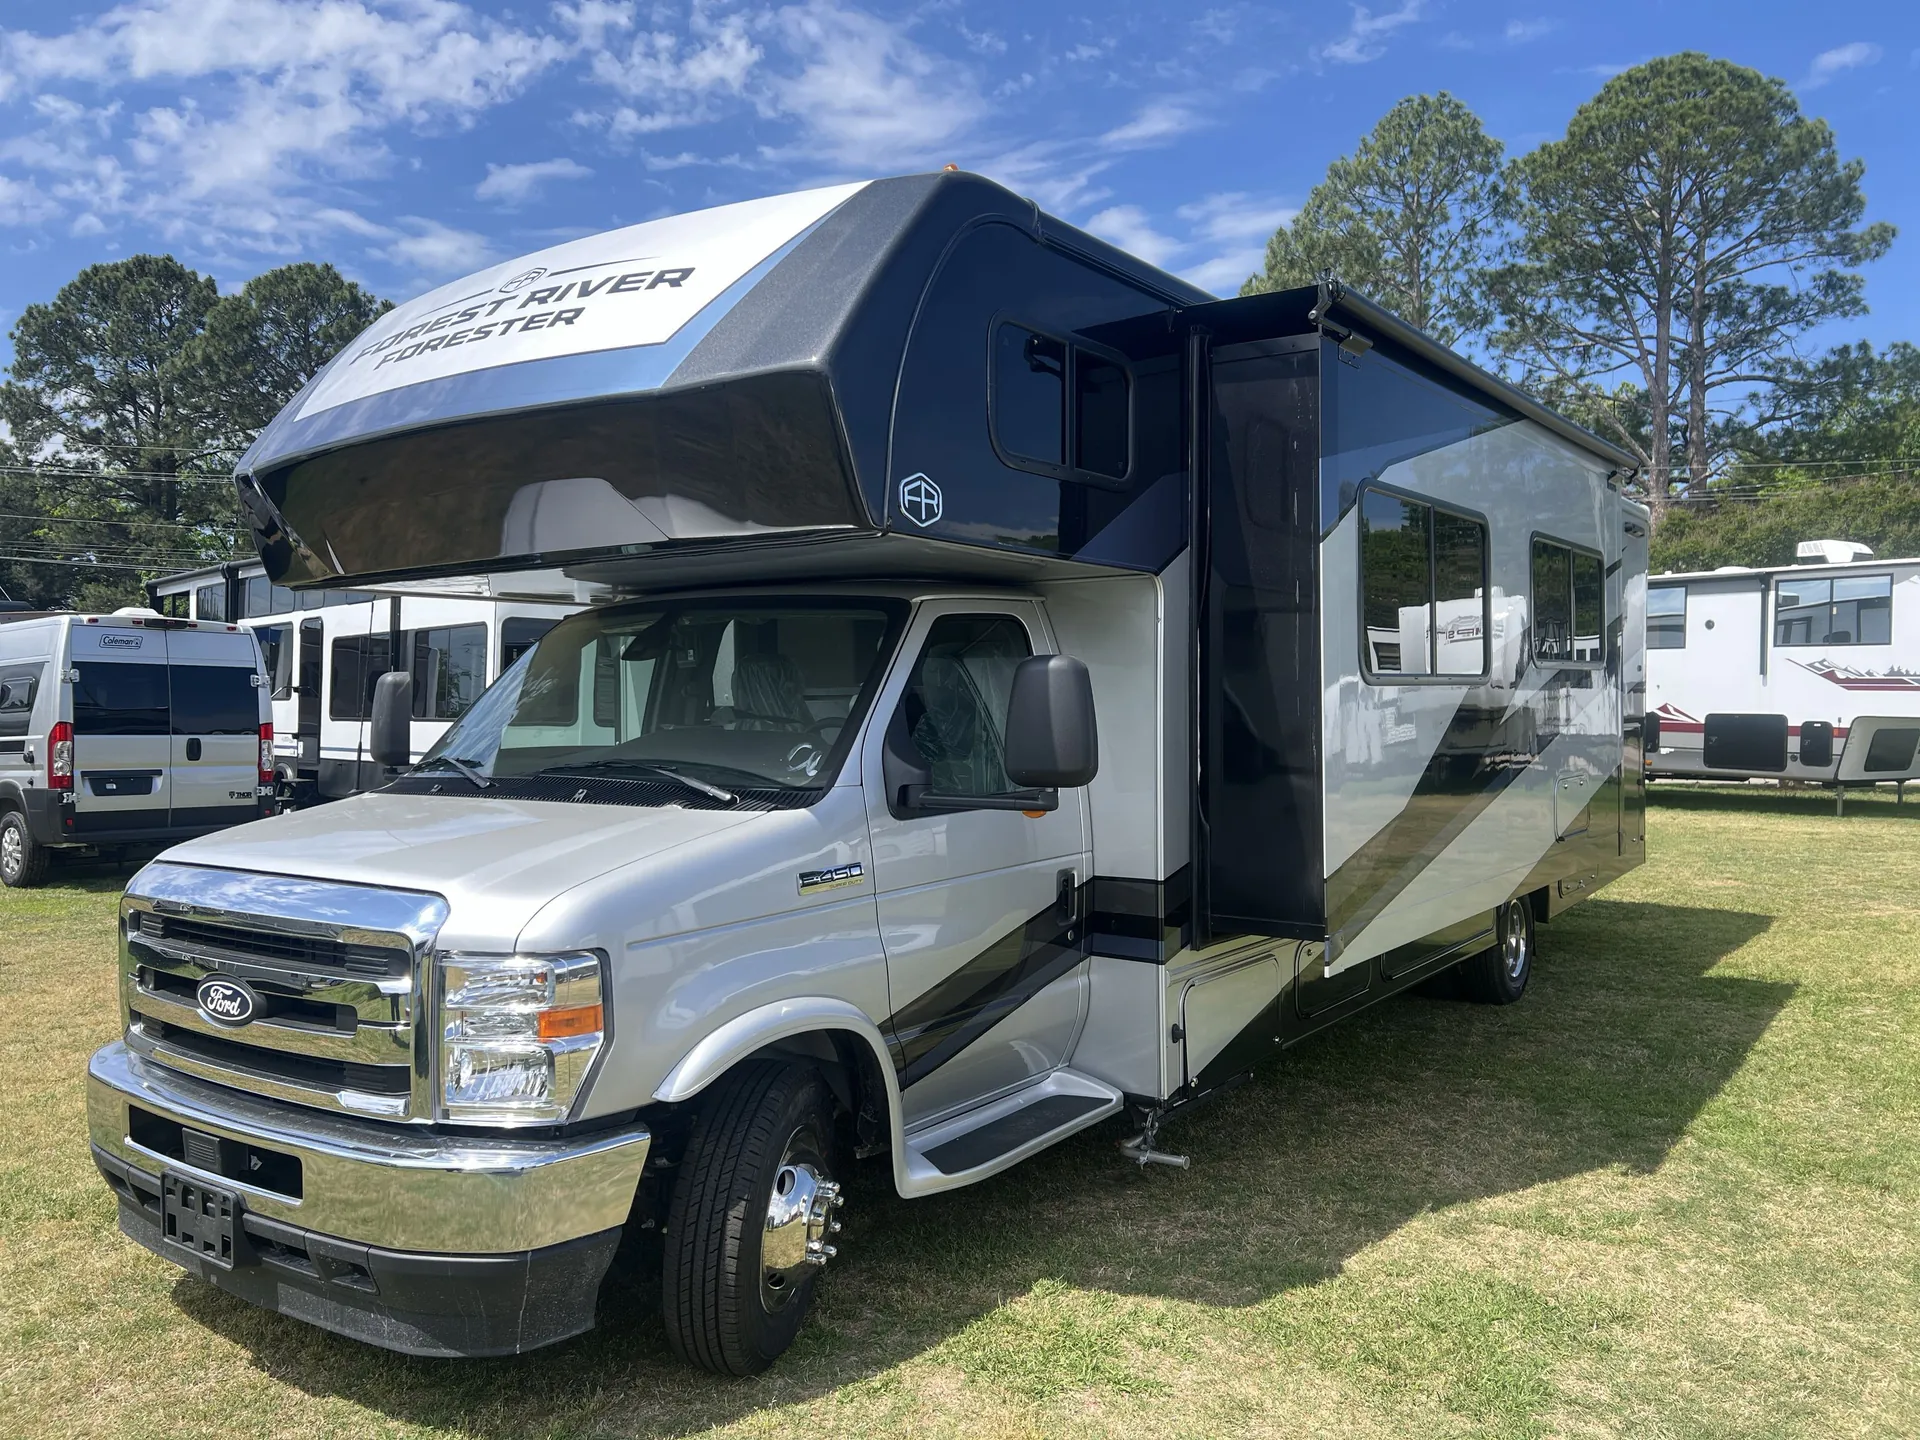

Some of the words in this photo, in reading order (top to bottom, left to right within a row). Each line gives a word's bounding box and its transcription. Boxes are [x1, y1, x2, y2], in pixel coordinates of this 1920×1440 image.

[349, 294, 520, 367] FOREST
[517, 266, 696, 309] RIVER
[373, 306, 586, 376] FORESTER
[102, 635, 134, 646] Coleman
[235, 791, 253, 799] THOR
[207, 985, 242, 1015] Ford
